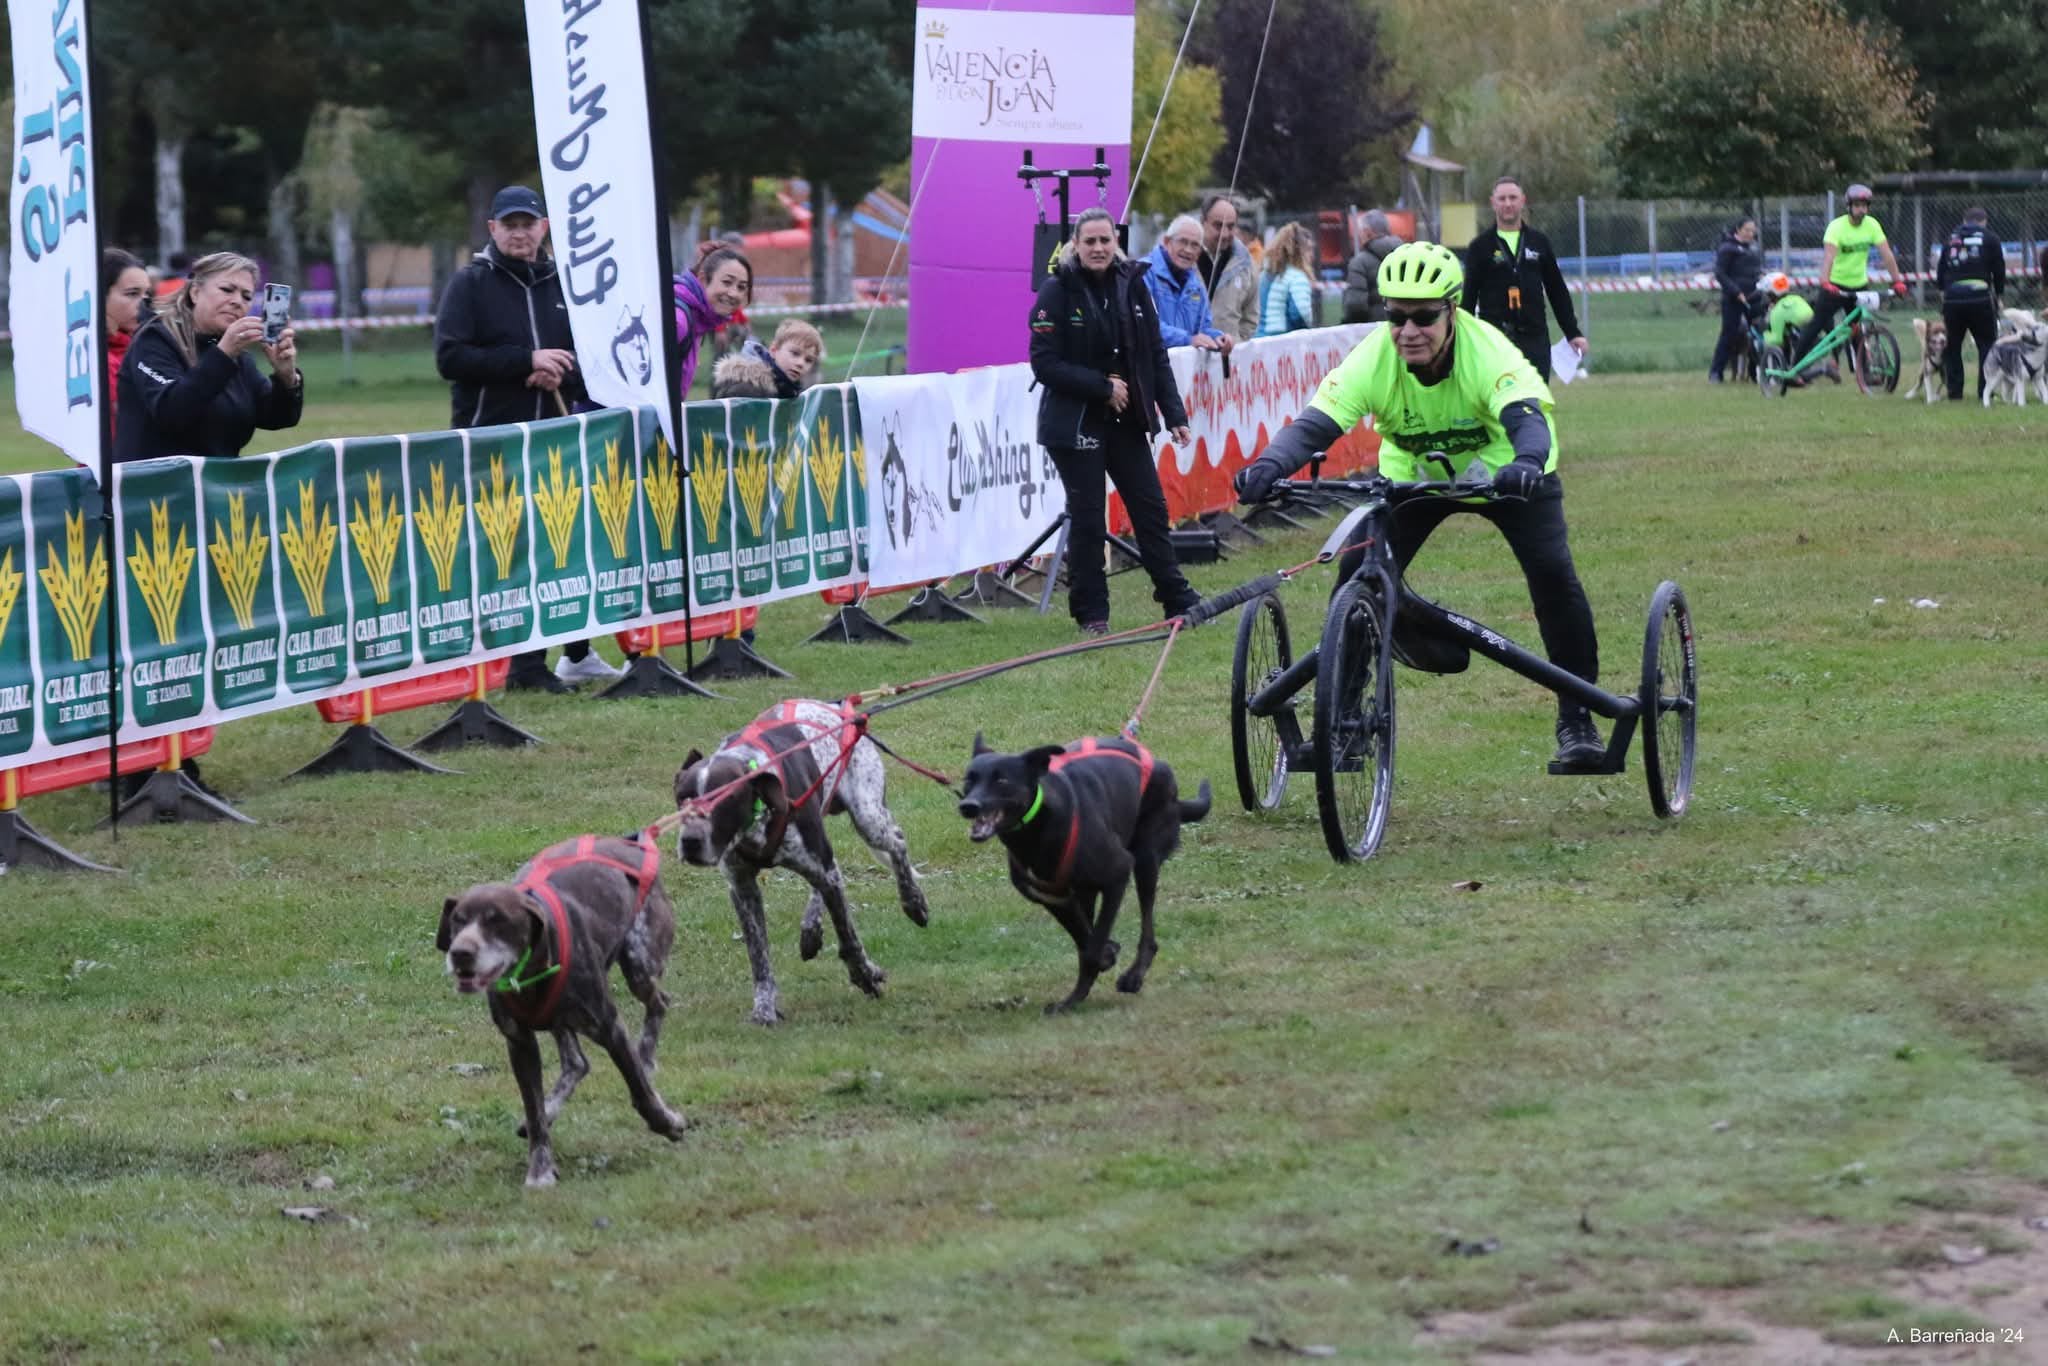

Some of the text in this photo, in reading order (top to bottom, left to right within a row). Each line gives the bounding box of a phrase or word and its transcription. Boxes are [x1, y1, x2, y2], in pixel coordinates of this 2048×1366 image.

[979, 79, 1056, 126] JUAN
[814, 532, 828, 551] CAJA
[695, 551, 731, 574] CAJA RURAL
[538, 576, 589, 602] CAJA RURAL
[598, 570, 616, 591] CAJA
[480, 586, 530, 615] CAJA RURAL
[549, 601, 580, 619] DE ZAMORA
[604, 594, 611, 607] DE
[420, 599, 472, 628] CAJA RURAL
[489, 613, 524, 631] DE ZAMORA
[355, 611, 410, 641] CAJA RURAL
[429, 626, 464, 645] DE ZAMORA
[287, 624, 345, 656] CAJA RURAL
[365, 639, 402, 659] DE ZAMORA
[215, 638, 276, 671] CAJA RURAL
[296, 653, 336, 674] DE ZAMORA
[133, 653, 203, 686] CAJA RURAL
[225, 668, 265, 688] DE ZAMORA
[45, 676, 77, 704] CAJA
[147, 683, 192, 705] DE ZAMORA
[59, 700, 111, 723] DE ZAMORA
